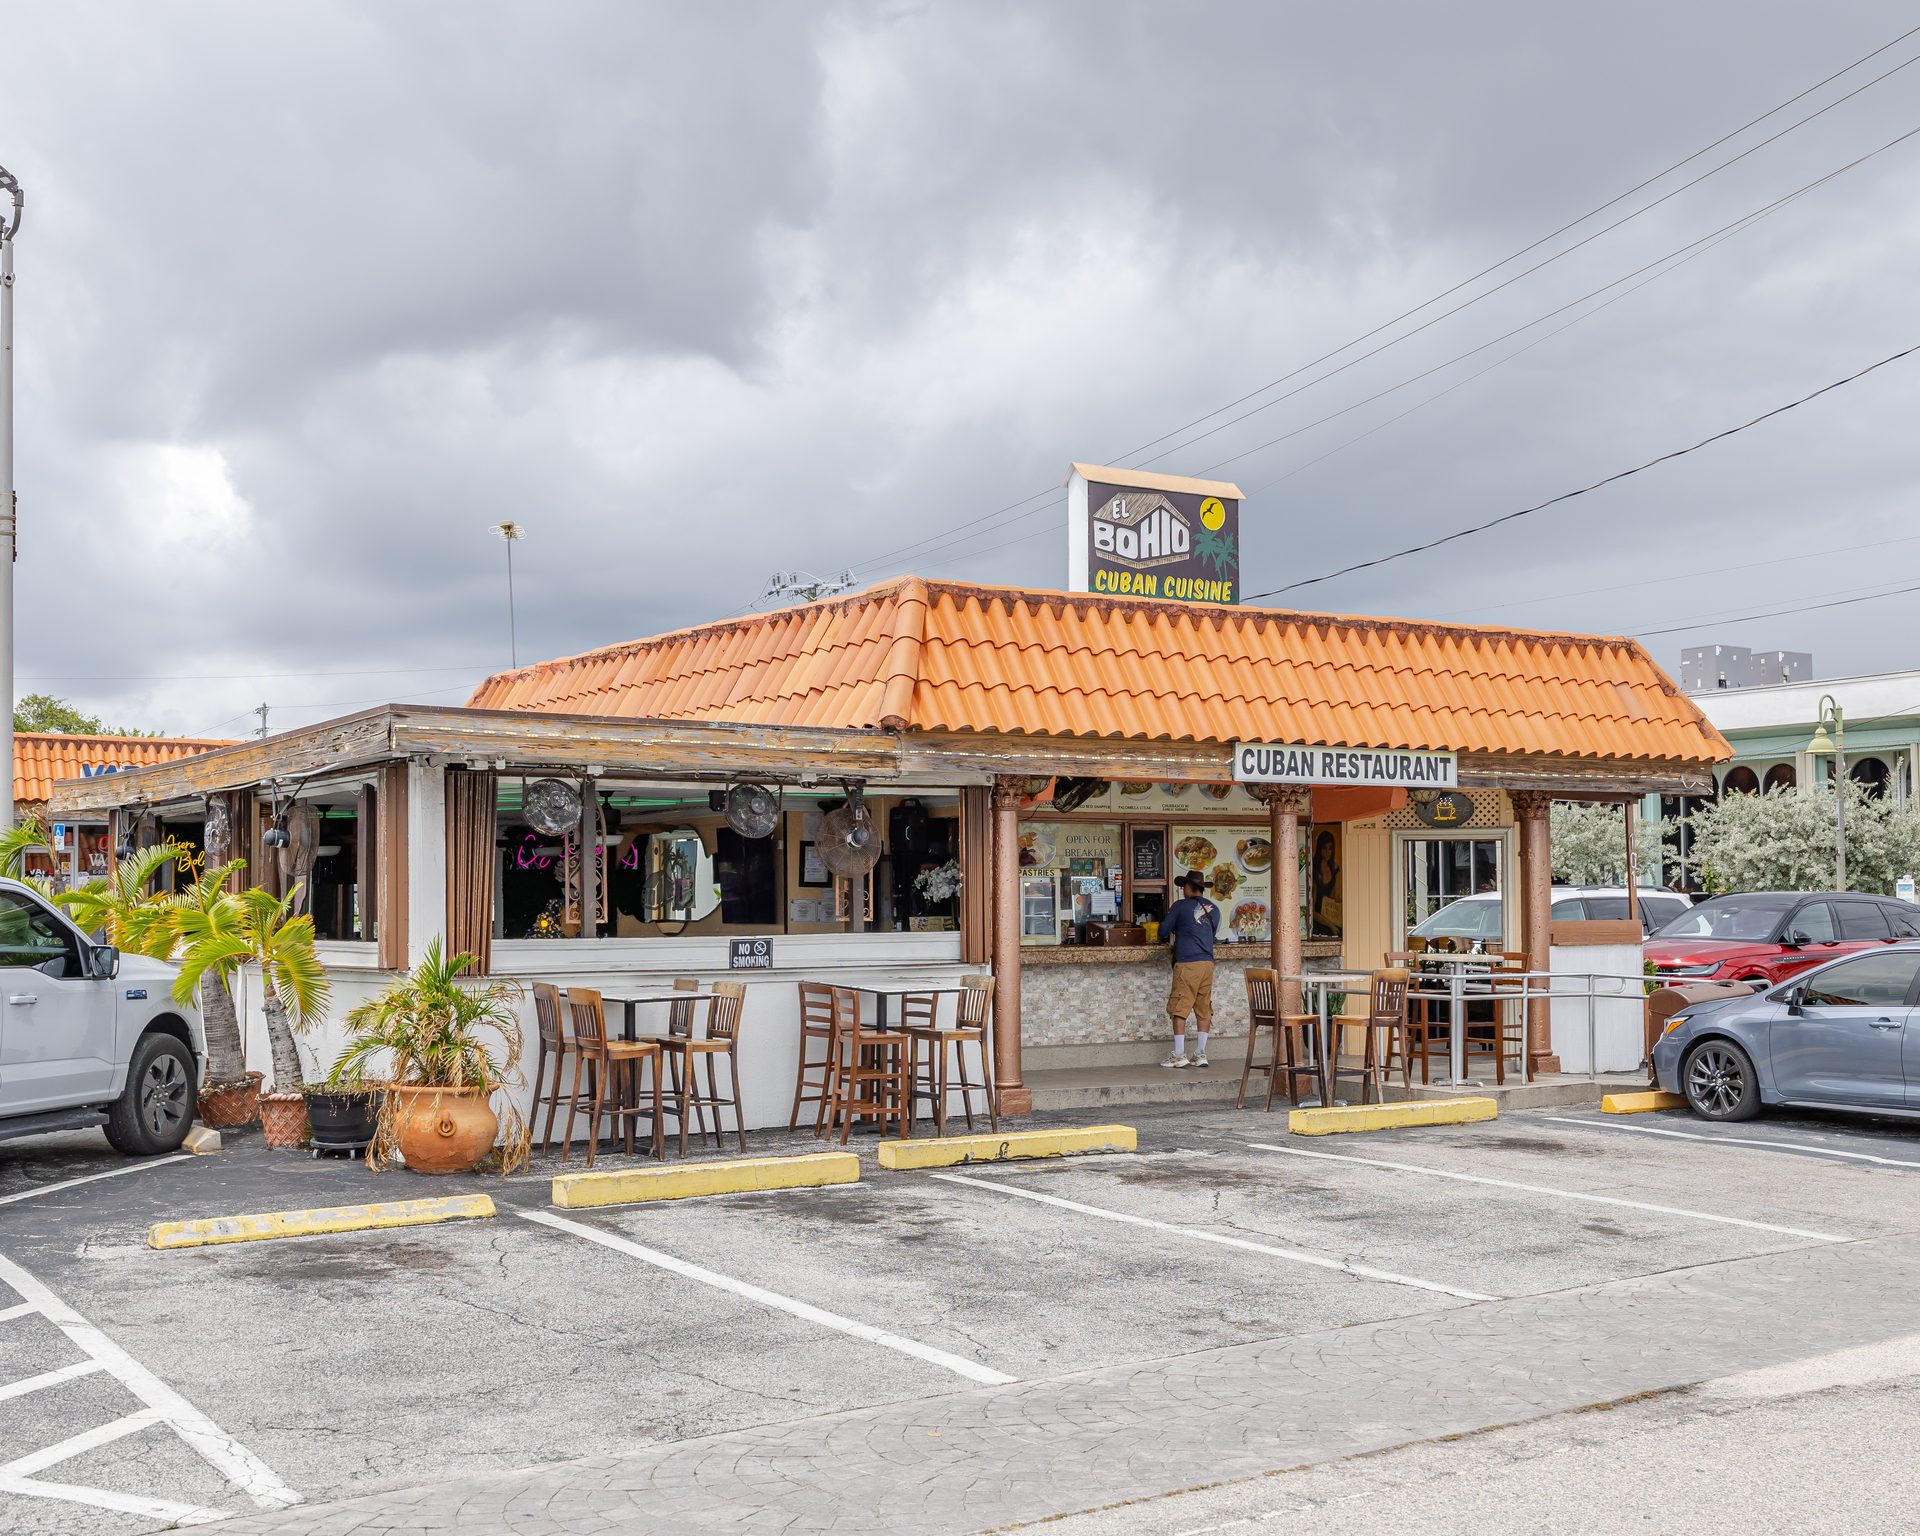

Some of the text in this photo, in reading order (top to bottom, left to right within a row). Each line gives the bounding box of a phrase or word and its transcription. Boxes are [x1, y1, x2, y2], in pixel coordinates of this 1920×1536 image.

[1112, 499, 1130, 520] EL
[1093, 508, 1190, 560] BOHIO
[1095, 569, 1233, 602] CUBAN CUISINE
[1241, 748, 1451, 782] CUBAN RESTAURANT
[1066, 835, 1111, 844] OPEN FOR
[1064, 848, 1113, 857] BREAKFAST
[1081, 879, 1102, 887] SHOP
[1081, 886, 1102, 894] LOCAL
[738, 943, 750, 955] NO
[732, 955, 770, 968] SMOKING
